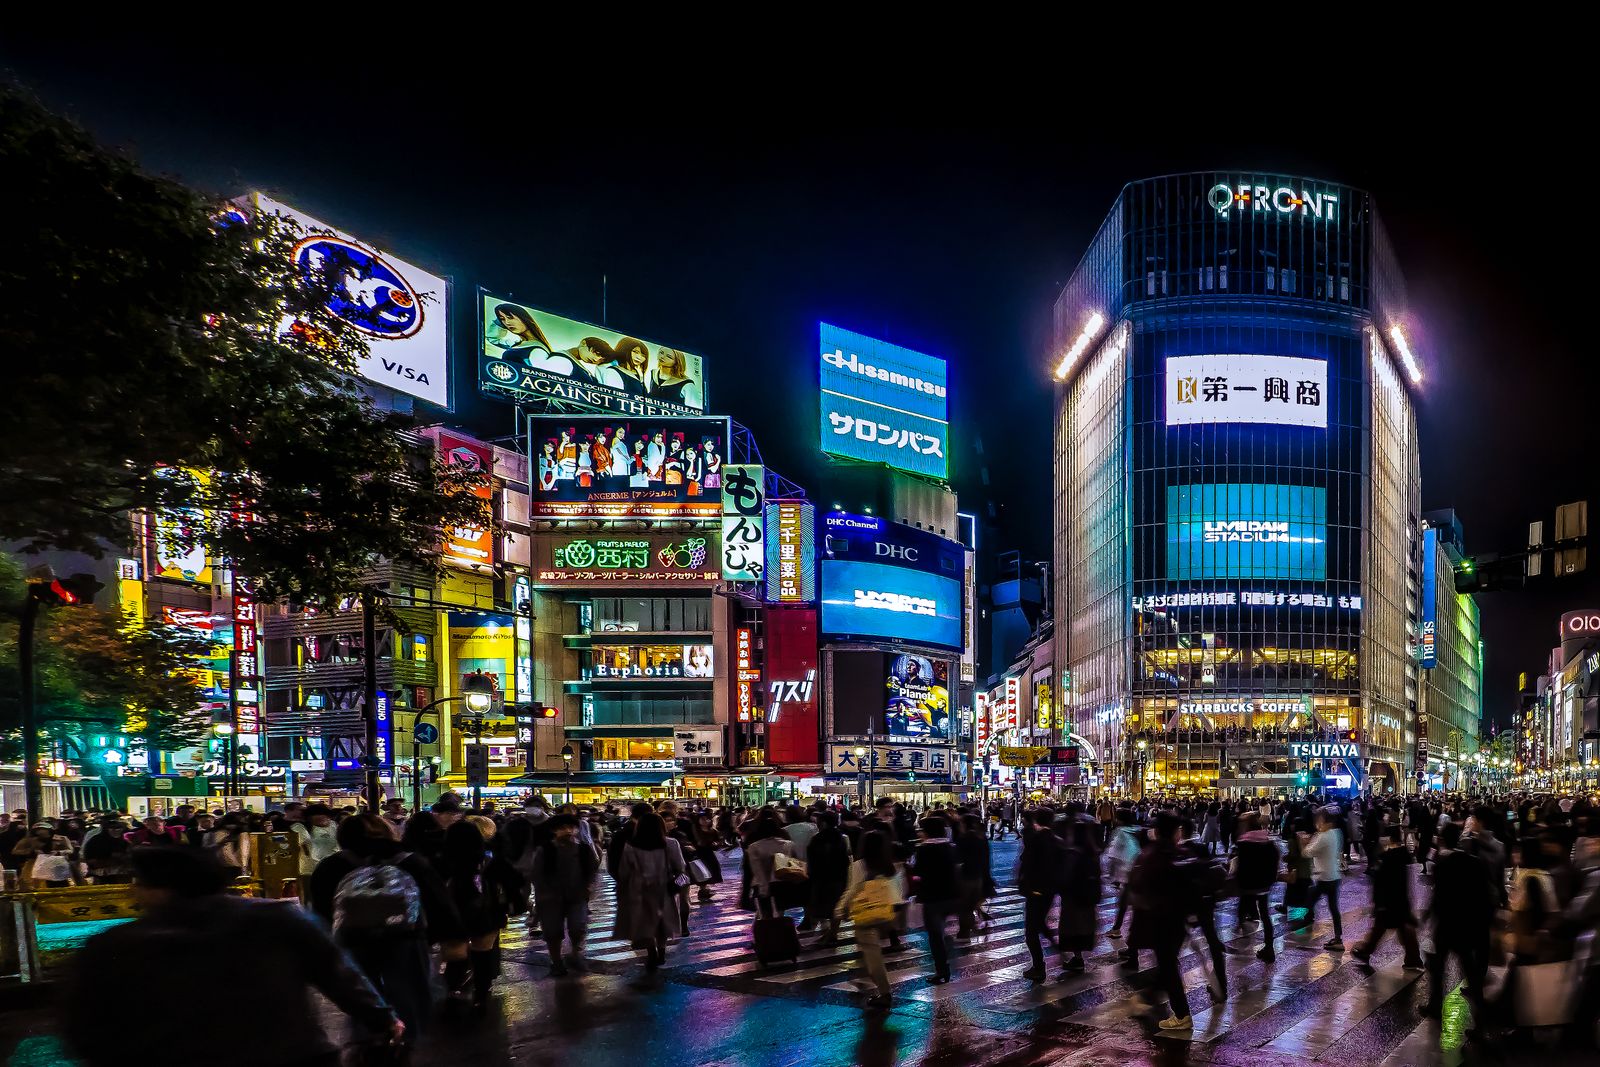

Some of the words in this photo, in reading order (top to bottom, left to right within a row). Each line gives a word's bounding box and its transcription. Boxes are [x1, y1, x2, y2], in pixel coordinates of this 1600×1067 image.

[1208, 184, 1337, 220] QFRONT
[380, 357, 429, 385] VISA
[822, 350, 946, 397] Hisamitsu
[521, 367, 547, 378] BRAND
[548, 374, 566, 382] NEW
[567, 379, 582, 387] IDOL
[583, 383, 611, 394] SOCIETY
[613, 389, 629, 398] FIRST
[671, 403, 703, 416] RELEASE
[1201, 376, 1320, 406] 第一興商
[617, 398, 656, 415] THE
[829, 412, 943, 458] サロンパス
[588, 491, 629, 501] ANGERME
[725, 467, 763, 578] もんじゃ
[827, 518, 844, 527] DHC
[846, 519, 878, 530] Channel
[1204, 532, 1288, 543] STADIUM
[598, 549, 649, 568] 西村
[781, 507, 797, 596] 三千里薬品
[875, 542, 918, 562] DHC
[1423, 621, 1435, 660] SEIBU
[597, 664, 679, 678] Euphoria
[768, 669, 816, 722] クスリ
[899, 687, 937, 702] Planets
[1180, 702, 1254, 713] STARBUCKS
[1260, 702, 1307, 713] COFFEE
[1291, 744, 1359, 757] TSUTAYA
[202, 761, 285, 777] グルタウン
